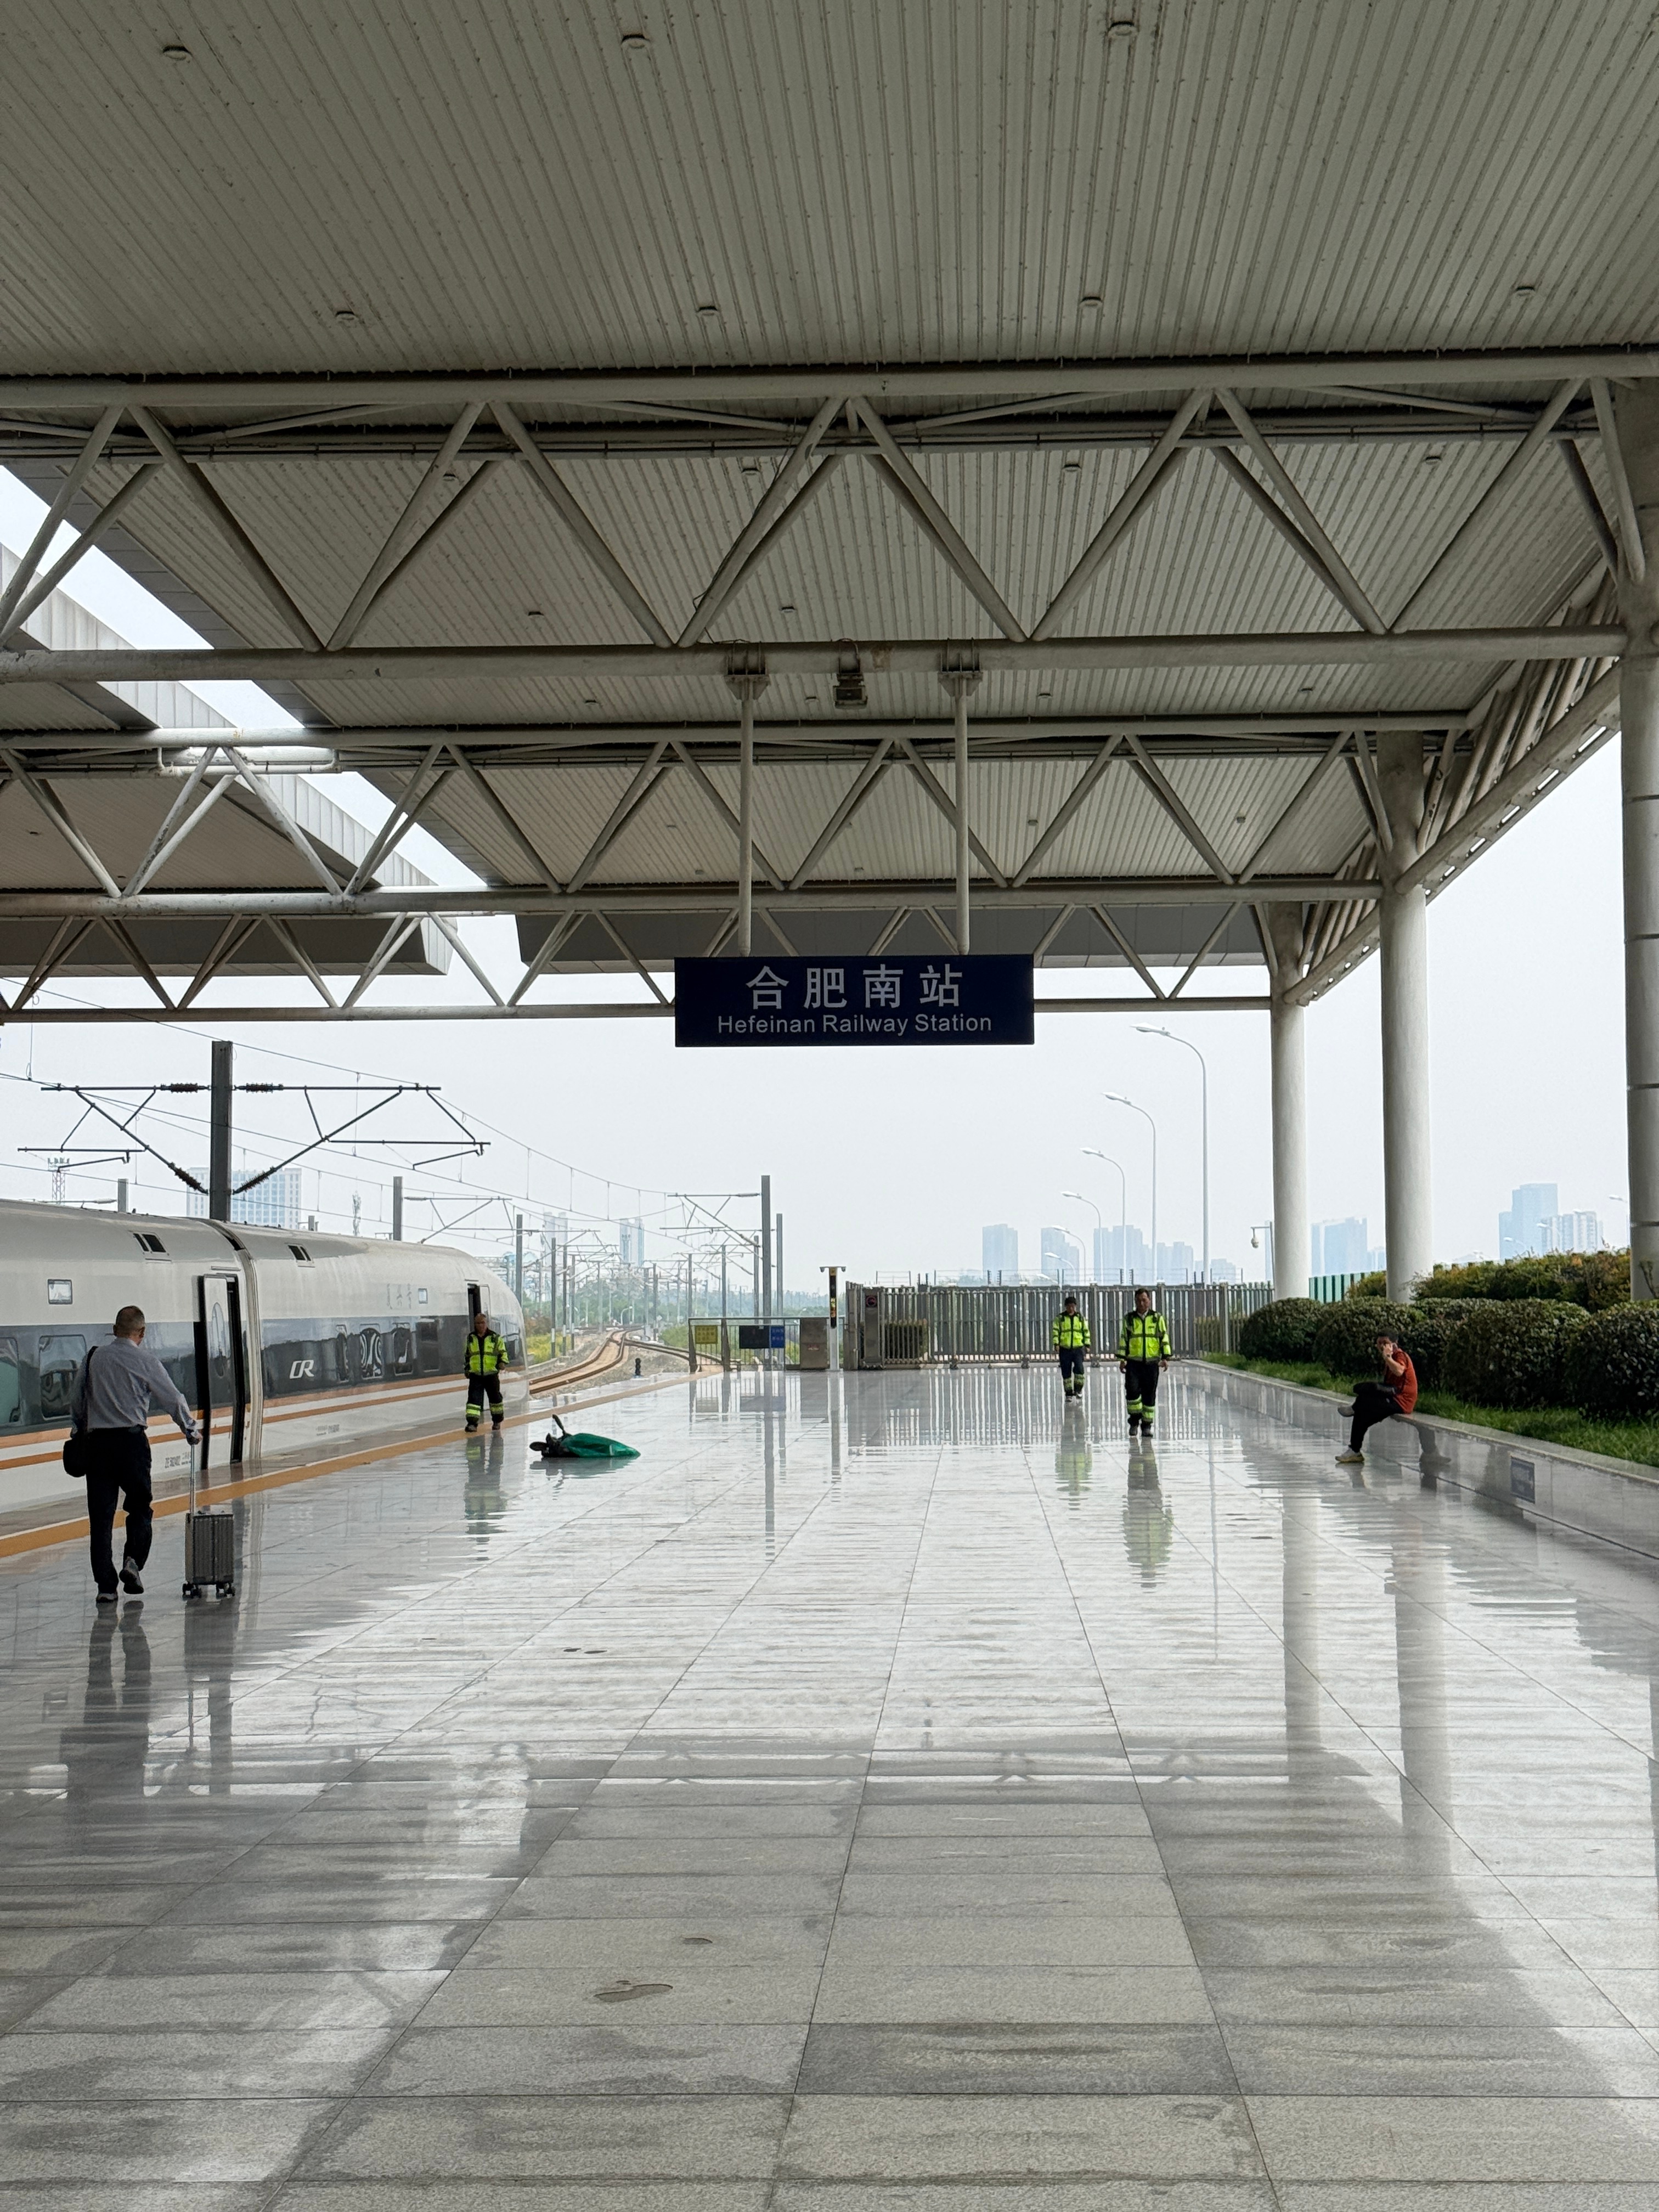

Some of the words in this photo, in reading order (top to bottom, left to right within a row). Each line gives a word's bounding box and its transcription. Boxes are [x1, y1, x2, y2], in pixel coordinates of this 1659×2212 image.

[746, 963, 962, 1009] 合肥南站
[718, 1015, 815, 1033] Hefeinan
[823, 1014, 909, 1036] Railway
[915, 1013, 991, 1031] Station
[289, 1359, 314, 1379] CR
